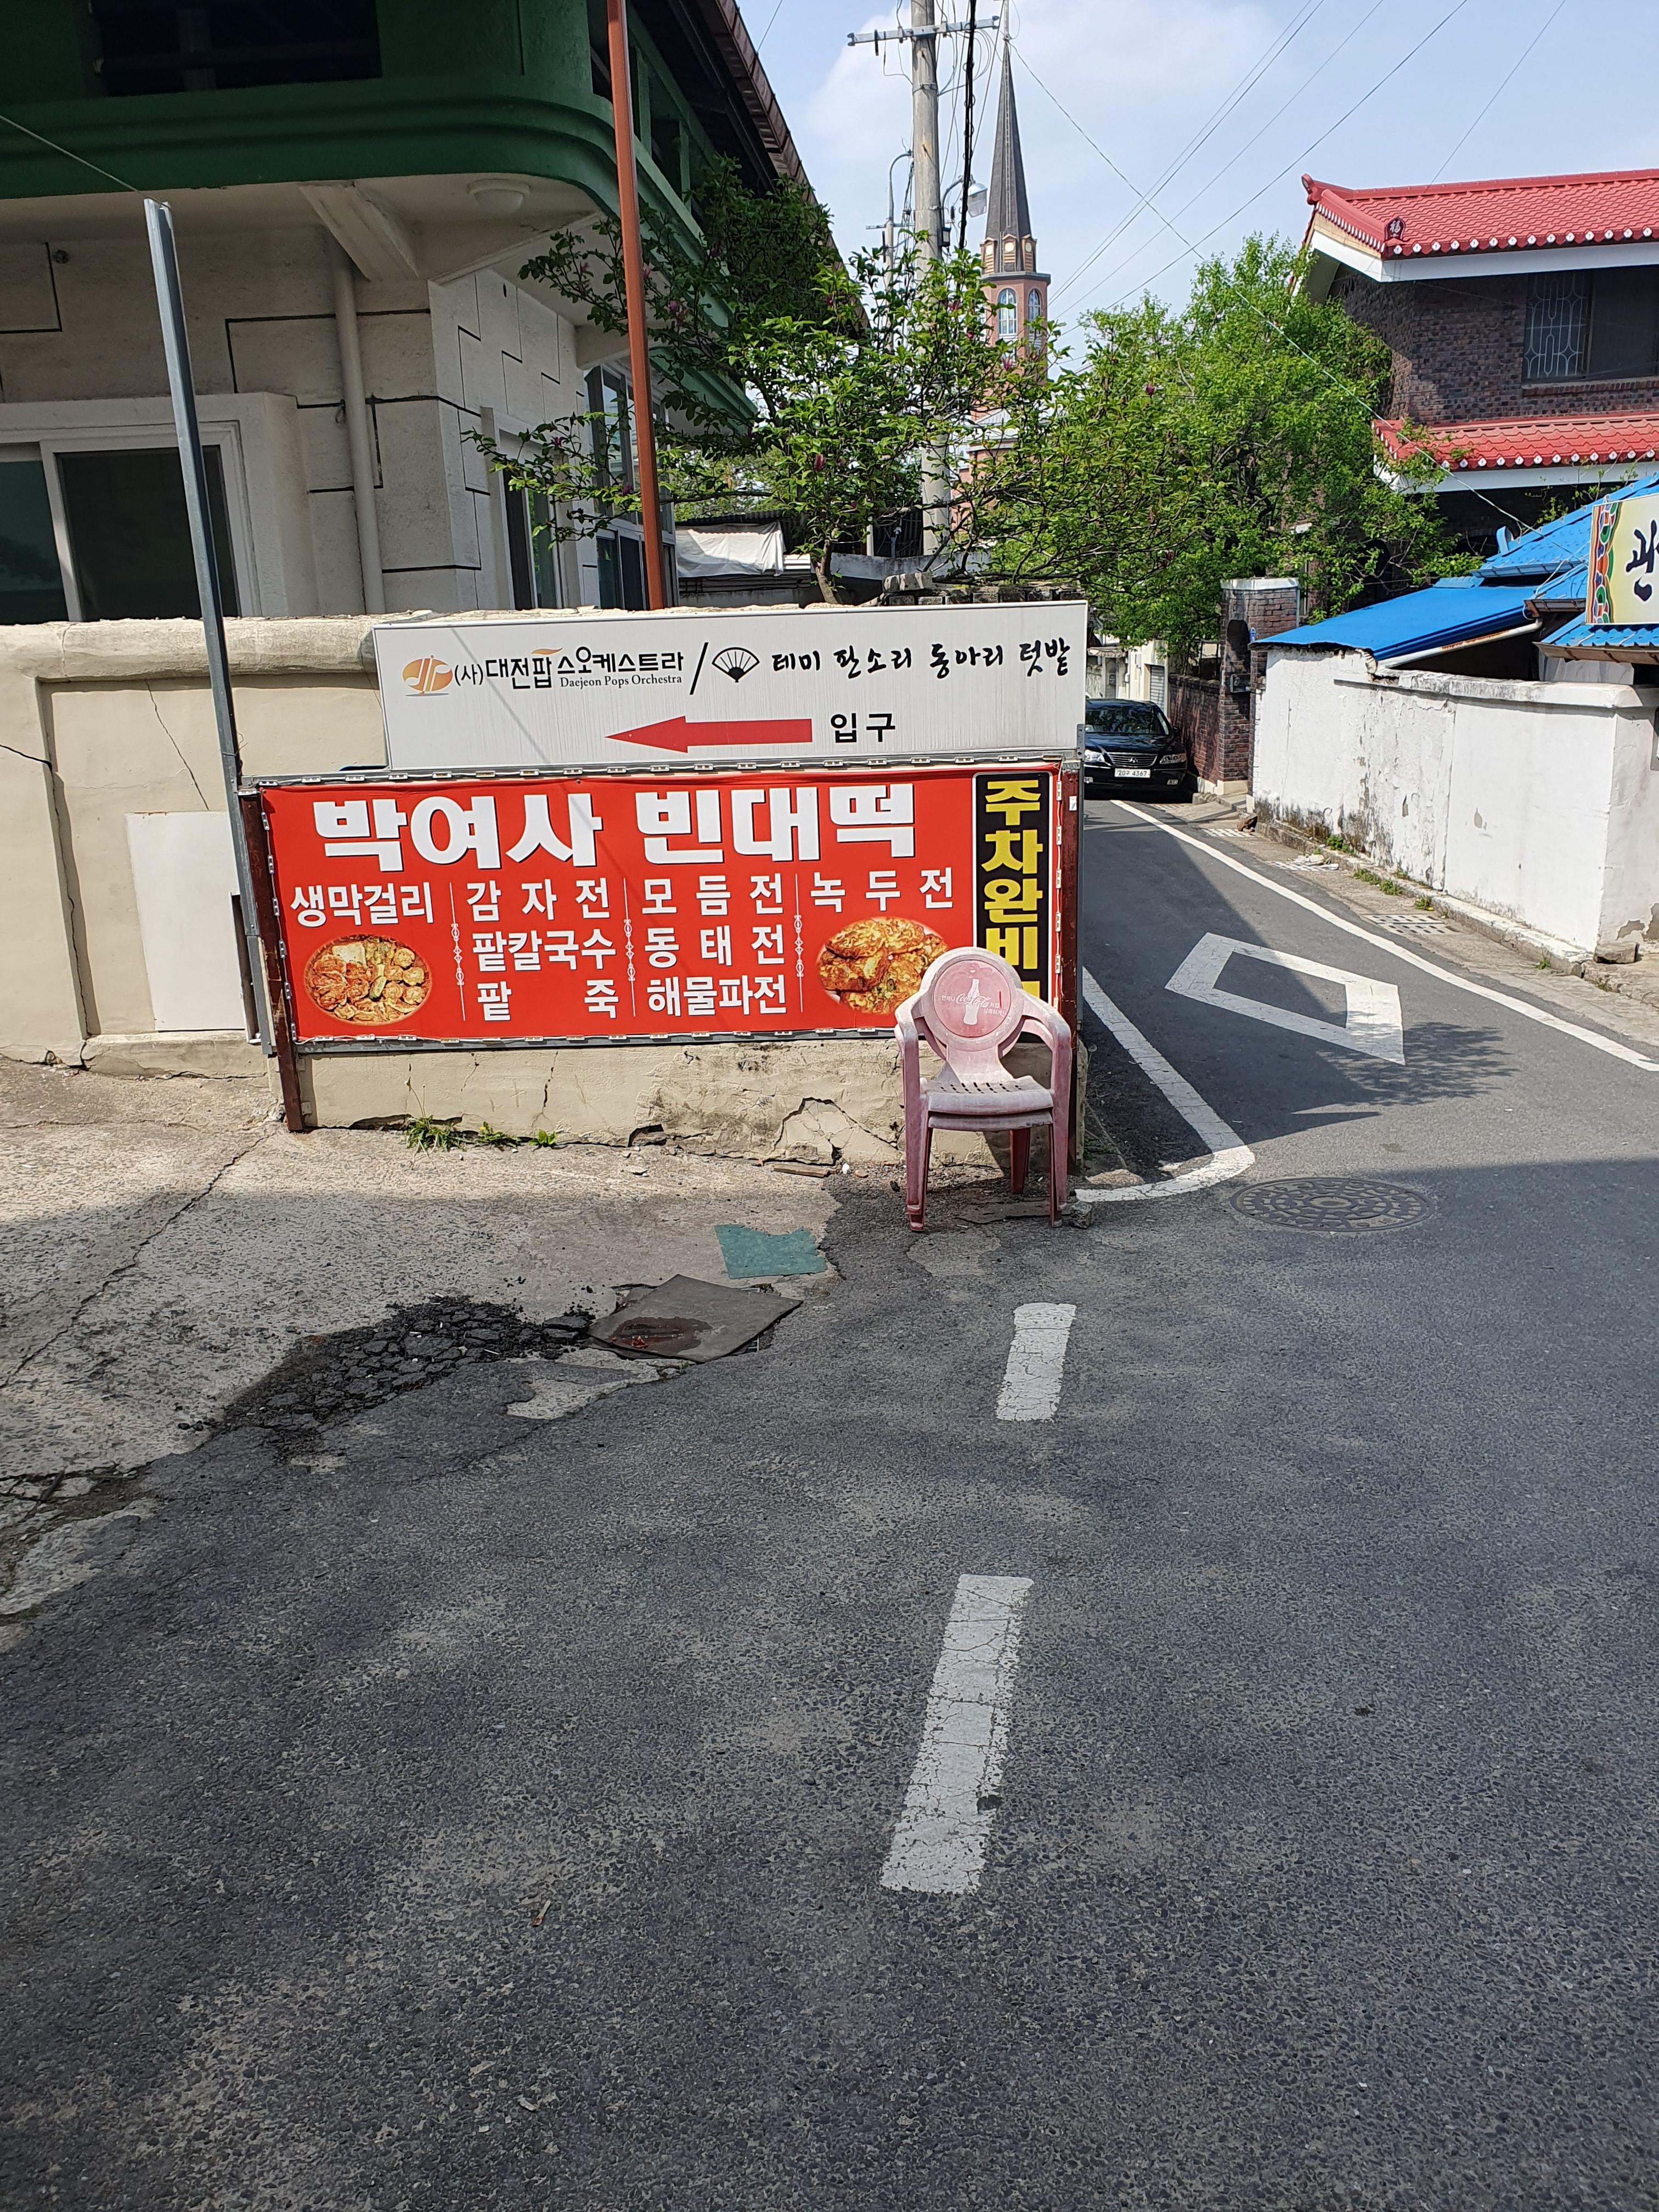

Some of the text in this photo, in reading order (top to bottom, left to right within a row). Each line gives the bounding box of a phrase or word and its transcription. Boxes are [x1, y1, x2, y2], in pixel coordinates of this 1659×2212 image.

[771, 650, 820, 672] 테미
[833, 645, 912, 679] 판소리
[929, 643, 1003, 679] 동아리
[1019, 637, 1070, 677] 텃밭
[560, 674, 682, 690] Daejeon Pops Orchestra
[830, 713, 896, 743] 입구
[313, 783, 915, 871] 박여사 빈대떡
[290, 882, 434, 927] 생막걸리
[982, 780, 1043, 999] 주차완비
[472, 929, 616, 972] 팥칼국수
[647, 974, 787, 1017] 해물파전
